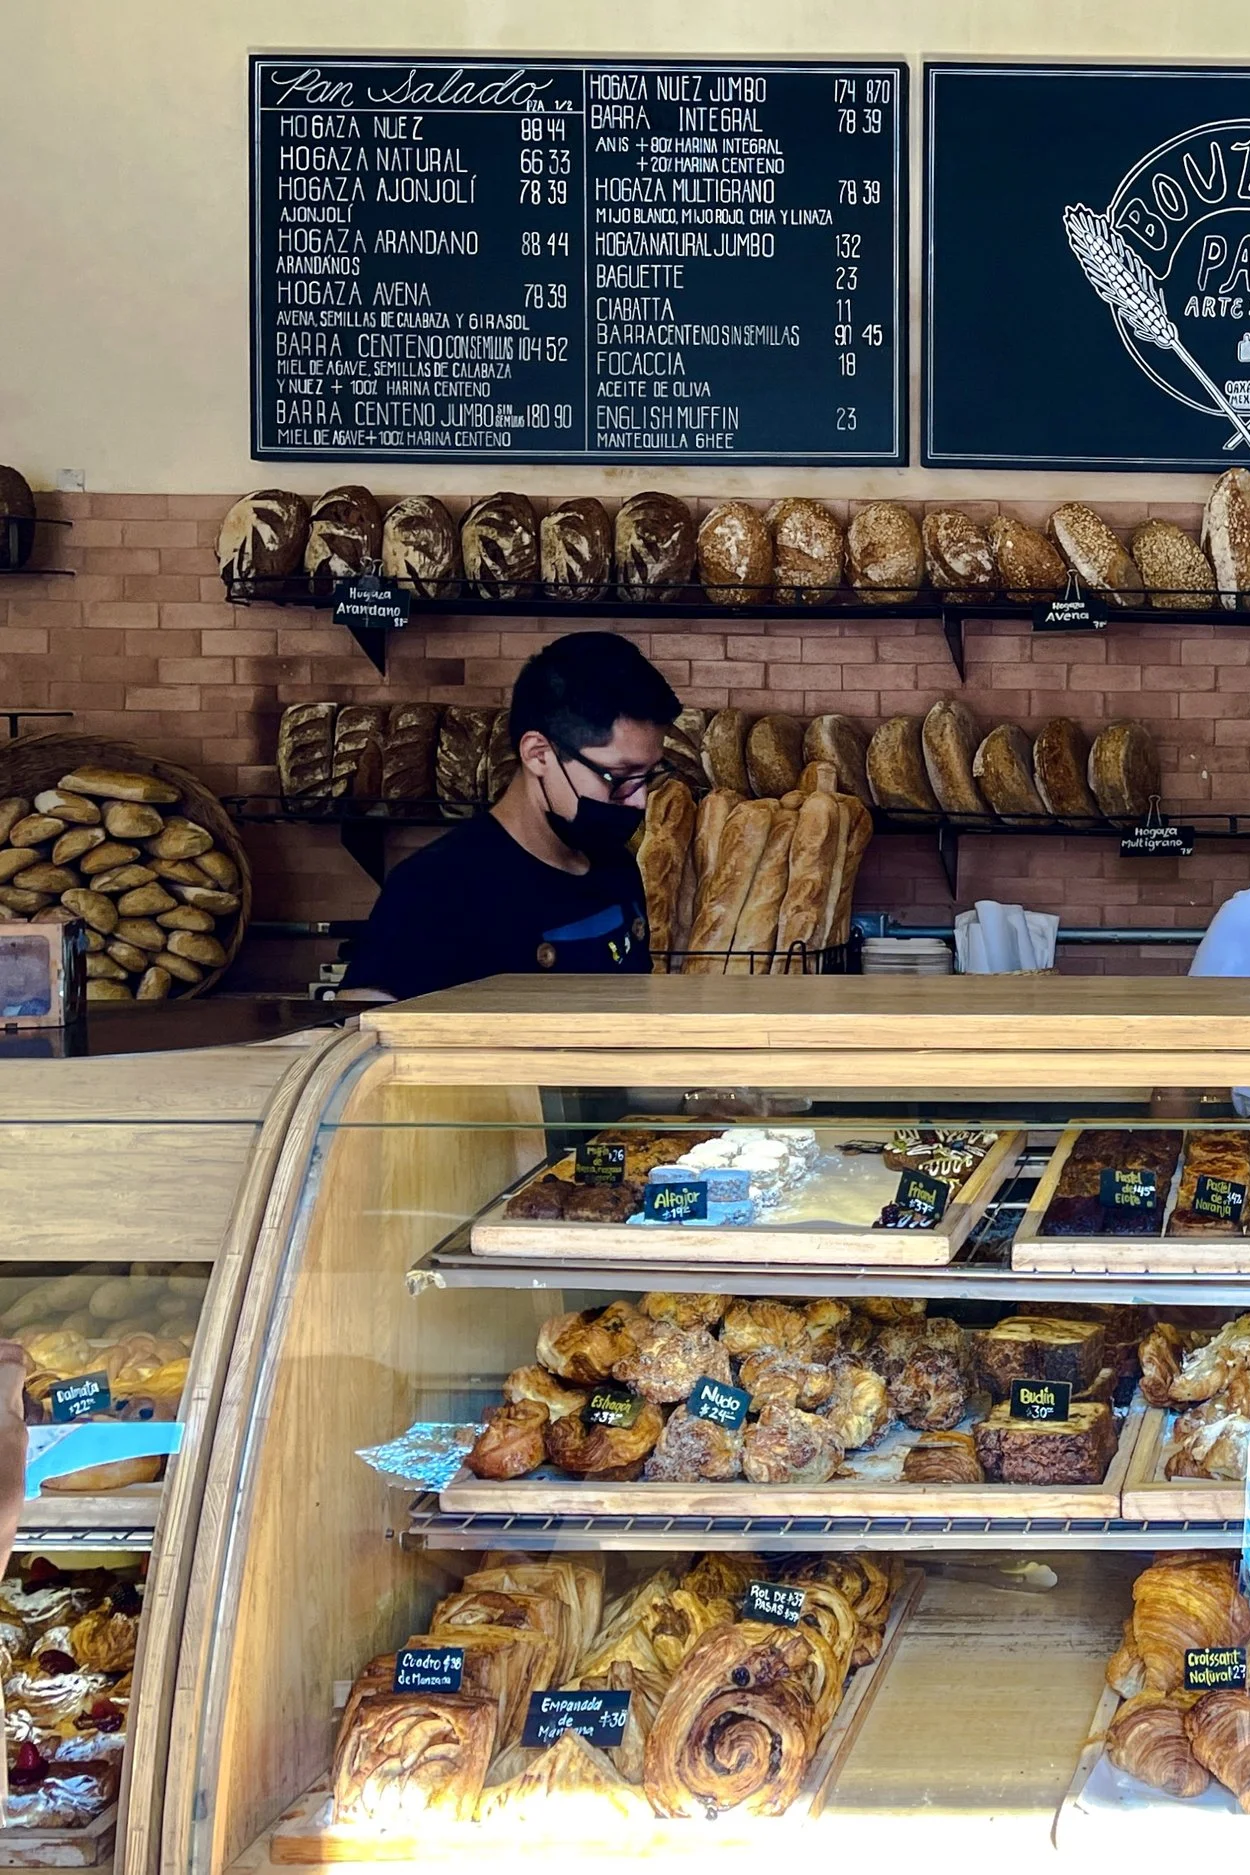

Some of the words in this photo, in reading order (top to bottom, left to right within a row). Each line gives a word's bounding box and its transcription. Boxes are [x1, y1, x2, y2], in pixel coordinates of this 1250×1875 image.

[271, 69, 353, 107] Pan
[368, 69, 553, 104] Salado
[590, 74, 648, 100] HOGAZA
[657, 75, 701, 101] NUEZ
[710, 78, 766, 102] JUMBO
[834, 79, 855, 103] 174
[867, 80, 890, 104] 870
[526, 100, 545, 112] PZA
[554, 100, 573, 111] 1/2
[280, 115, 360, 139] HOGAZA
[374, 117, 423, 140] NUEZ
[521, 119, 542, 141] 88
[547, 119, 565, 141] 44
[591, 105, 650, 130] BARRA
[679, 106, 763, 132] INTEGRAL
[838, 109, 855, 133] 78
[862, 110, 882, 133] 39
[280, 146, 369, 171] HOGAZA
[376, 148, 468, 172] NATURAL
[521, 150, 543, 172] 66
[548, 150, 570, 174] 33
[279, 177, 365, 201] HOGAZA
[377, 175, 477, 203] AJONJOLÍ
[519, 181, 540, 204] 78
[548, 181, 567, 204] 39
[596, 177, 666, 203] HOGAZA
[672, 179, 774, 204] MULTIGRANO
[838, 181, 857, 204] 78
[863, 181, 880, 203] 39
[280, 204, 353, 222] AJONJOLÍ
[596, 208, 630, 223] MIJO
[681, 209, 713, 225] MIJO
[750, 209, 776, 225] CHIA
[780, 210, 789, 224] Y
[791, 209, 833, 225] LINAZA
[278, 229, 366, 254] HOGAZA
[374, 230, 478, 255] ARANDANO
[521, 232, 540, 256] 88
[548, 233, 569, 256] 44
[596, 232, 648, 257] HOGAZA
[650, 232, 712, 257] NATURAL
[713, 233, 774, 258] JUMBO
[835, 234, 861, 258] 132
[596, 264, 684, 289] BAGUETTE
[836, 267, 858, 290] 23
[278, 281, 362, 305] HOGAZA
[373, 282, 431, 306] AVENA
[525, 284, 543, 308] 78
[547, 284, 567, 308] 39
[597, 297, 674, 321] CIABATTA
[836, 299, 851, 323] 11
[320, 312, 375, 328] SEMILLAS
[382, 312, 395, 328] DE
[397, 312, 450, 328] CALABAZA
[455, 314, 464, 328] Y
[469, 314, 530, 330] GIRASOL
[276, 332, 342, 356] BARRA
[358, 333, 441, 359] CENTENO
[518, 337, 542, 360] 104
[547, 337, 568, 361] 52
[278, 361, 306, 376] MIEL
[309, 361, 323, 376] DE
[374, 362, 431, 378] SEMILLAS
[434, 362, 449, 378] DE
[452, 363, 512, 379] CALABAZA
[597, 351, 685, 376] FOCACCIA
[838, 353, 856, 376] 18
[597, 381, 647, 398] ACEITE
[654, 382, 668, 398] DE
[673, 382, 711, 398] OLIVA
[276, 400, 342, 425] BARRA
[355, 401, 434, 426] CENTENO
[440, 403, 494, 428] JUMBO
[527, 405, 549, 428] 180
[554, 405, 572, 428] 90
[596, 405, 672, 430] ENGLISH
[678, 406, 739, 430] MUFFIN
[836, 408, 857, 430] 23
[597, 433, 688, 449] MANTEQUILLA
[696, 433, 734, 449] GHEE
[336, 602, 400, 617] Arandano
[1045, 612, 1089, 622] Avena
[1052, 602, 1085, 611] Hogaza
[1121, 838, 1183, 851] Multigrano
[1135, 827, 1177, 839] Hogaza
[1115, 1171, 1142, 1184] Pastel
[1206, 1179, 1231, 1194] Pastel
[654, 1188, 700, 1209] Alfajor
[1195, 1198, 1231, 1218] Naranja
[701, 1385, 740, 1411] Nudo
[751, 1585, 770, 1600] ROL
[774, 1592, 786, 1603] DE
[754, 1598, 784, 1615] PASAS
[403, 1653, 441, 1670] Cuadro
[1188, 1648, 1241, 1667] Croissant
[398, 1669, 410, 1685] de
[558, 1713, 573, 1727] de
